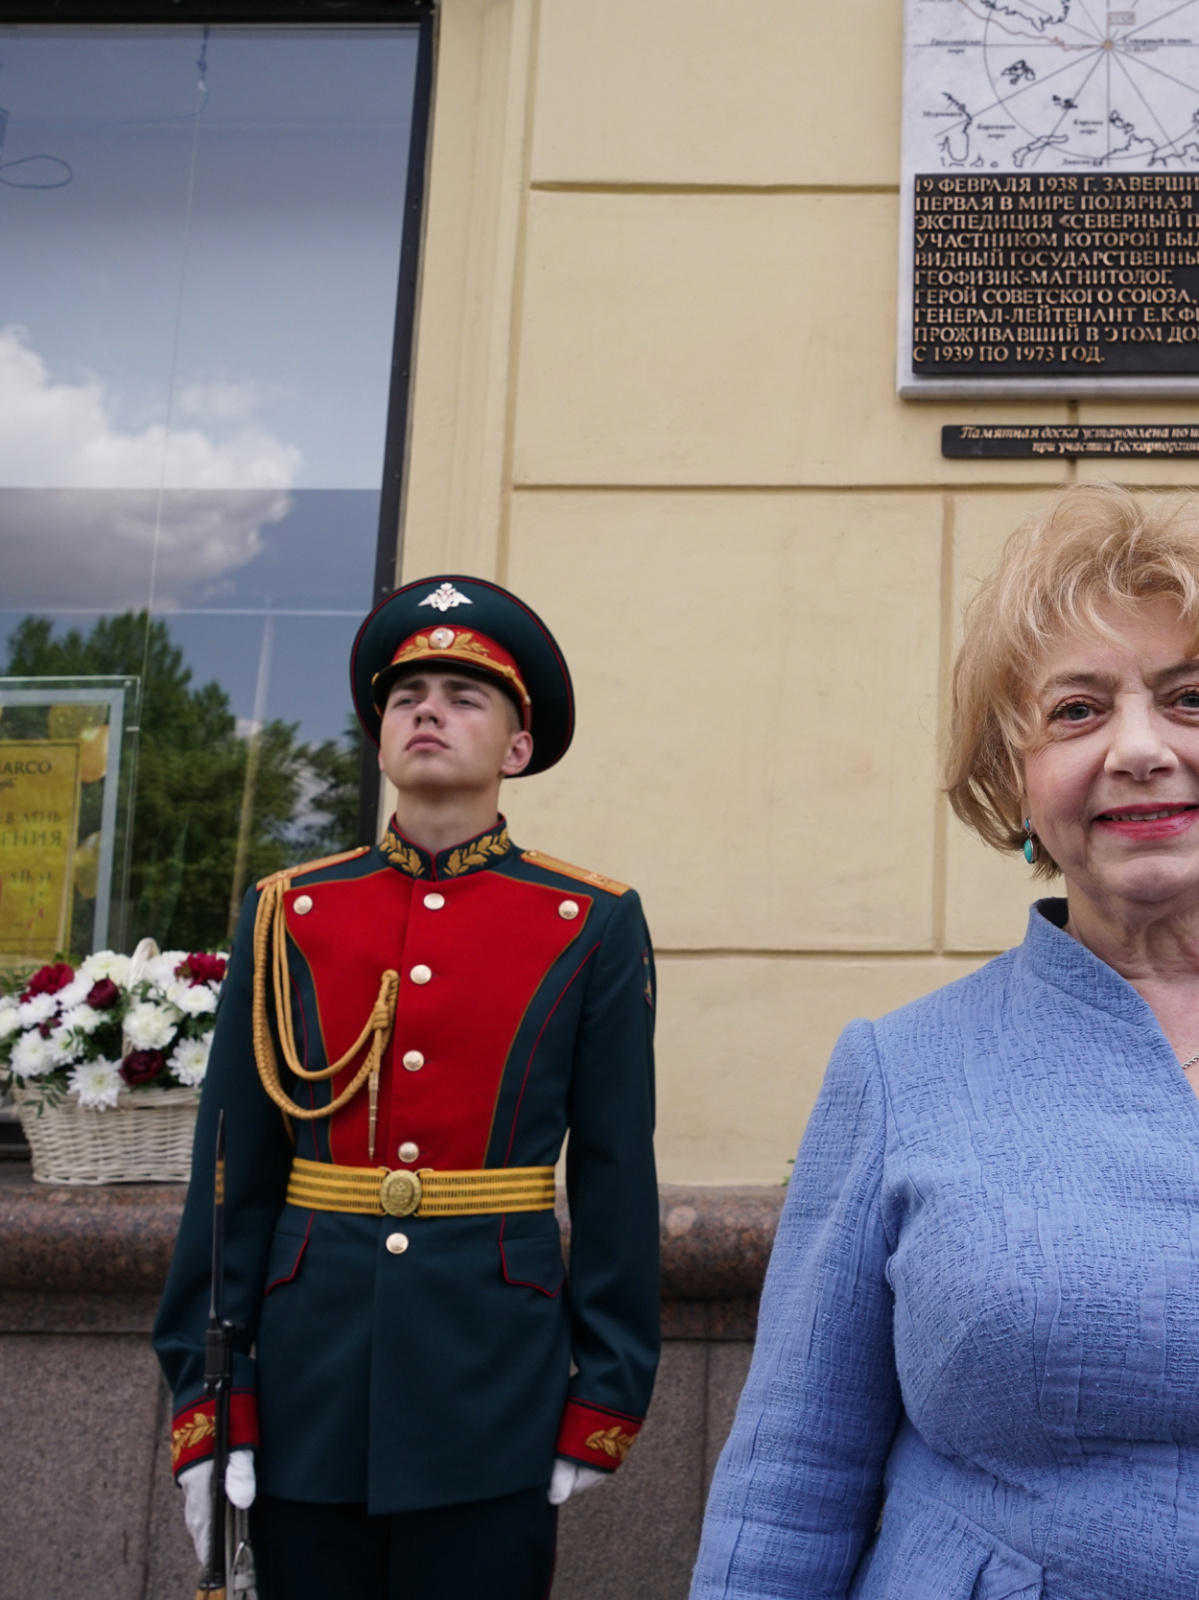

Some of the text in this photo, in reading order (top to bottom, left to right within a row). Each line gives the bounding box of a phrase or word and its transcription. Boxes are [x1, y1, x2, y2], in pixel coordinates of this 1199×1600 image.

[916, 178, 934, 192] 19
[938, 177, 1031, 193] ФЕВРАЛЯ
[1038, 177, 1078, 192] 1938
[1083, 177, 1098, 192] Г.
[916, 195, 1193, 211] ПЕРВАЯ В МИРЕ ПОЛЯРНАЯ
[916, 214, 1053, 231] ЭКСПЕДИЦИЯ
[1059, 211, 1181, 229] «СЕВЕРНЫЙ
[916, 233, 1057, 248] УЧАСТНИКОМ
[1064, 229, 1158, 247] КОТОРОЙ
[916, 249, 1003, 268] ВИДНЫЙ
[915, 286, 977, 304] ГЕРОЙ
[982, 288, 1113, 304] СОВЕТСКОГО
[915, 305, 1136, 323] ГЕНЕРАЛ-ЛЕЙТЕНАНТ
[914, 324, 1079, 342] ПРОЖИВАВШИЙ
[1086, 327, 1099, 342] В
[1104, 326, 1162, 342] ЭТОМ
[913, 346, 1105, 363] С 1939 ПО 1973 ГОД.
[959, 426, 1040, 440] Памятная
[1041, 426, 1079, 439] доска
[1082, 427, 1170, 440] установлена
[1171, 427, 1188, 438] по
[1031, 442, 1055, 454] при
[1058, 442, 1112, 454] участии
